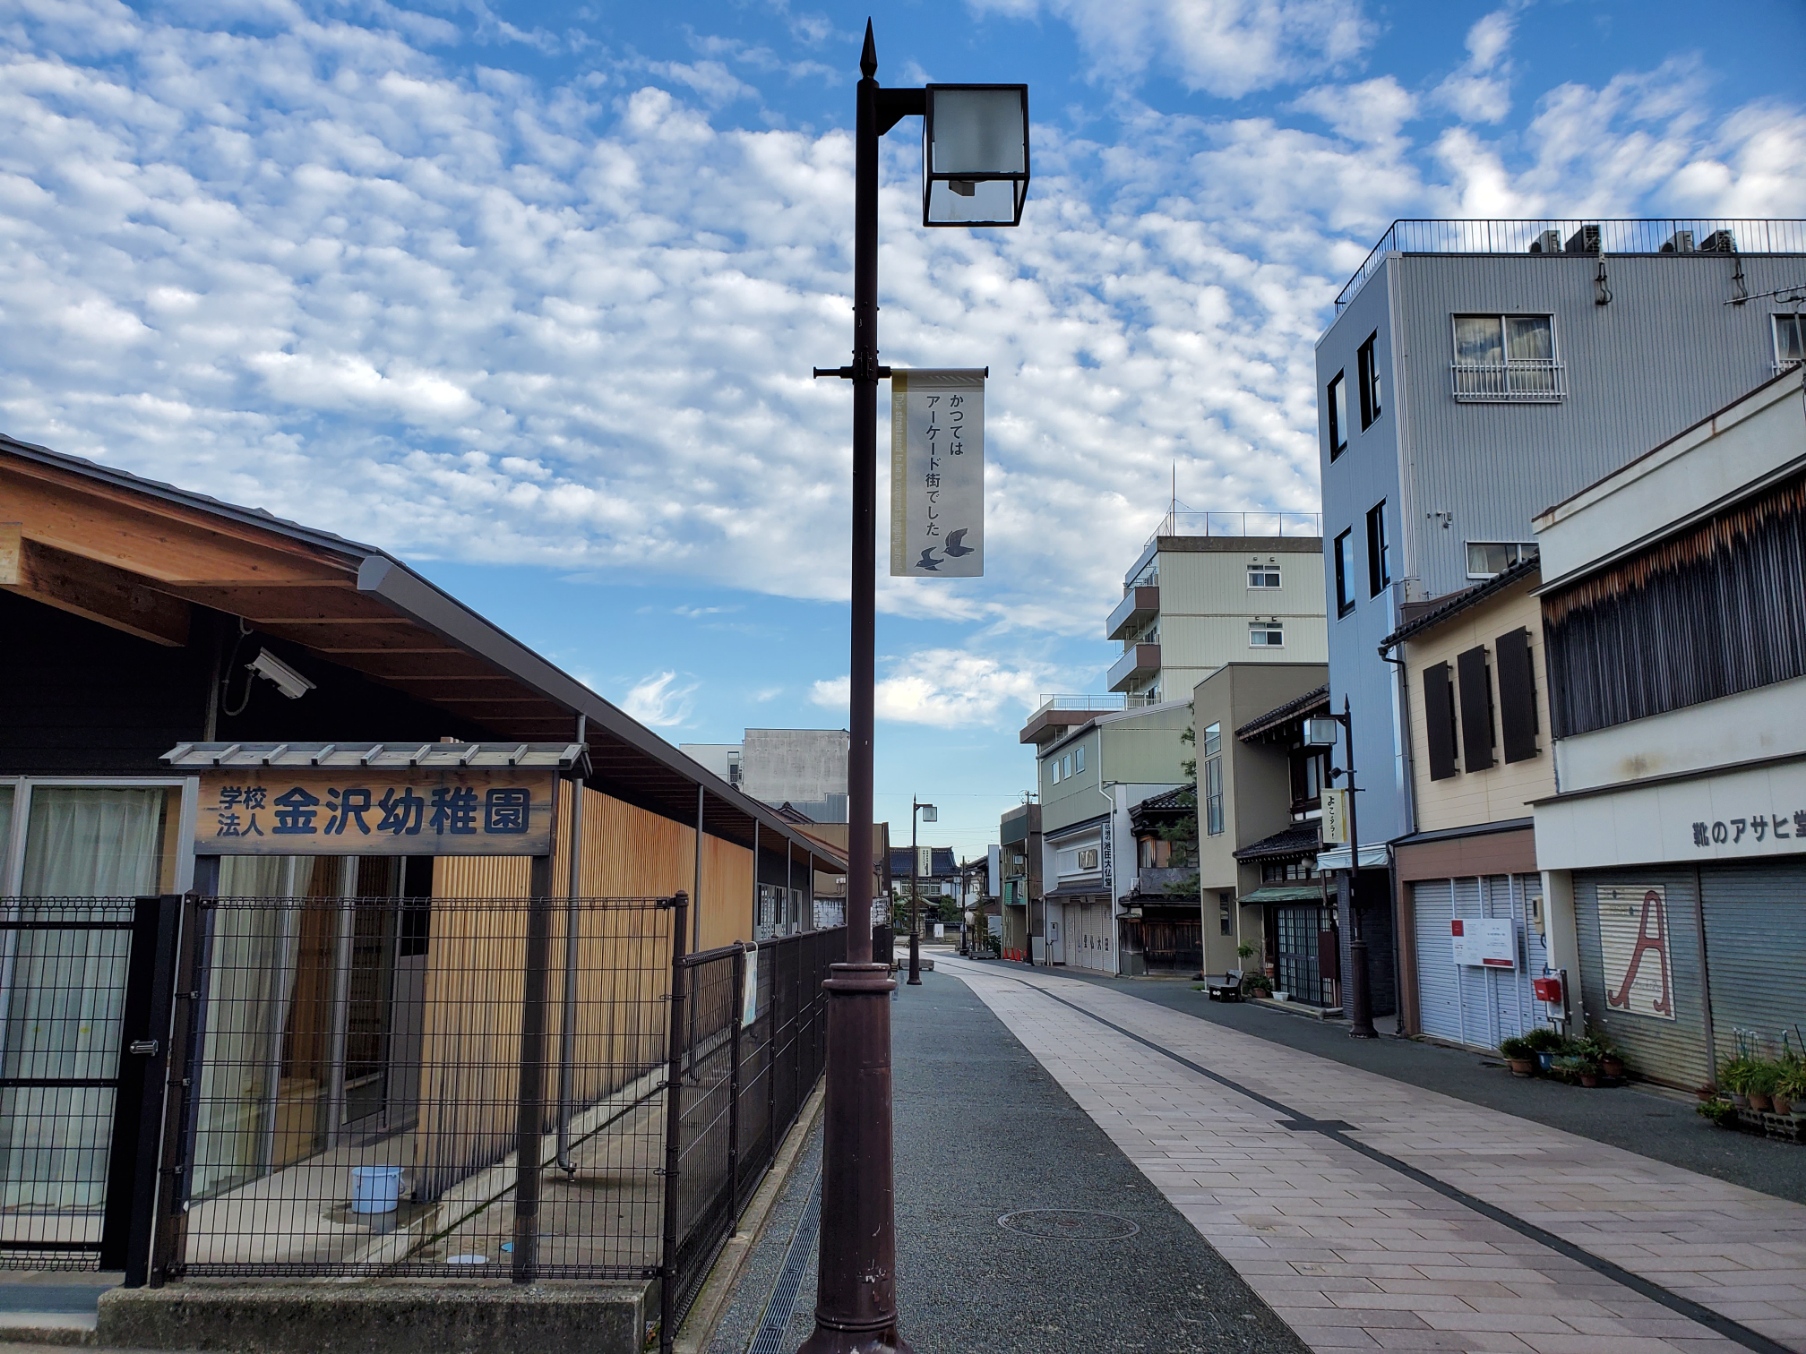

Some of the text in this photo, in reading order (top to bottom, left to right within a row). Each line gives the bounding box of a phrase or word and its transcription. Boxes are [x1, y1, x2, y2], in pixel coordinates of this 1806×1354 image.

[895, 411, 904, 433] street
[949, 394, 964, 456] かつては
[925, 395, 942, 537] アーケード街でした
[218, 785, 266, 810] 学校
[271, 786, 531, 836] 金沢幼稚園
[216, 812, 264, 838] 法人
